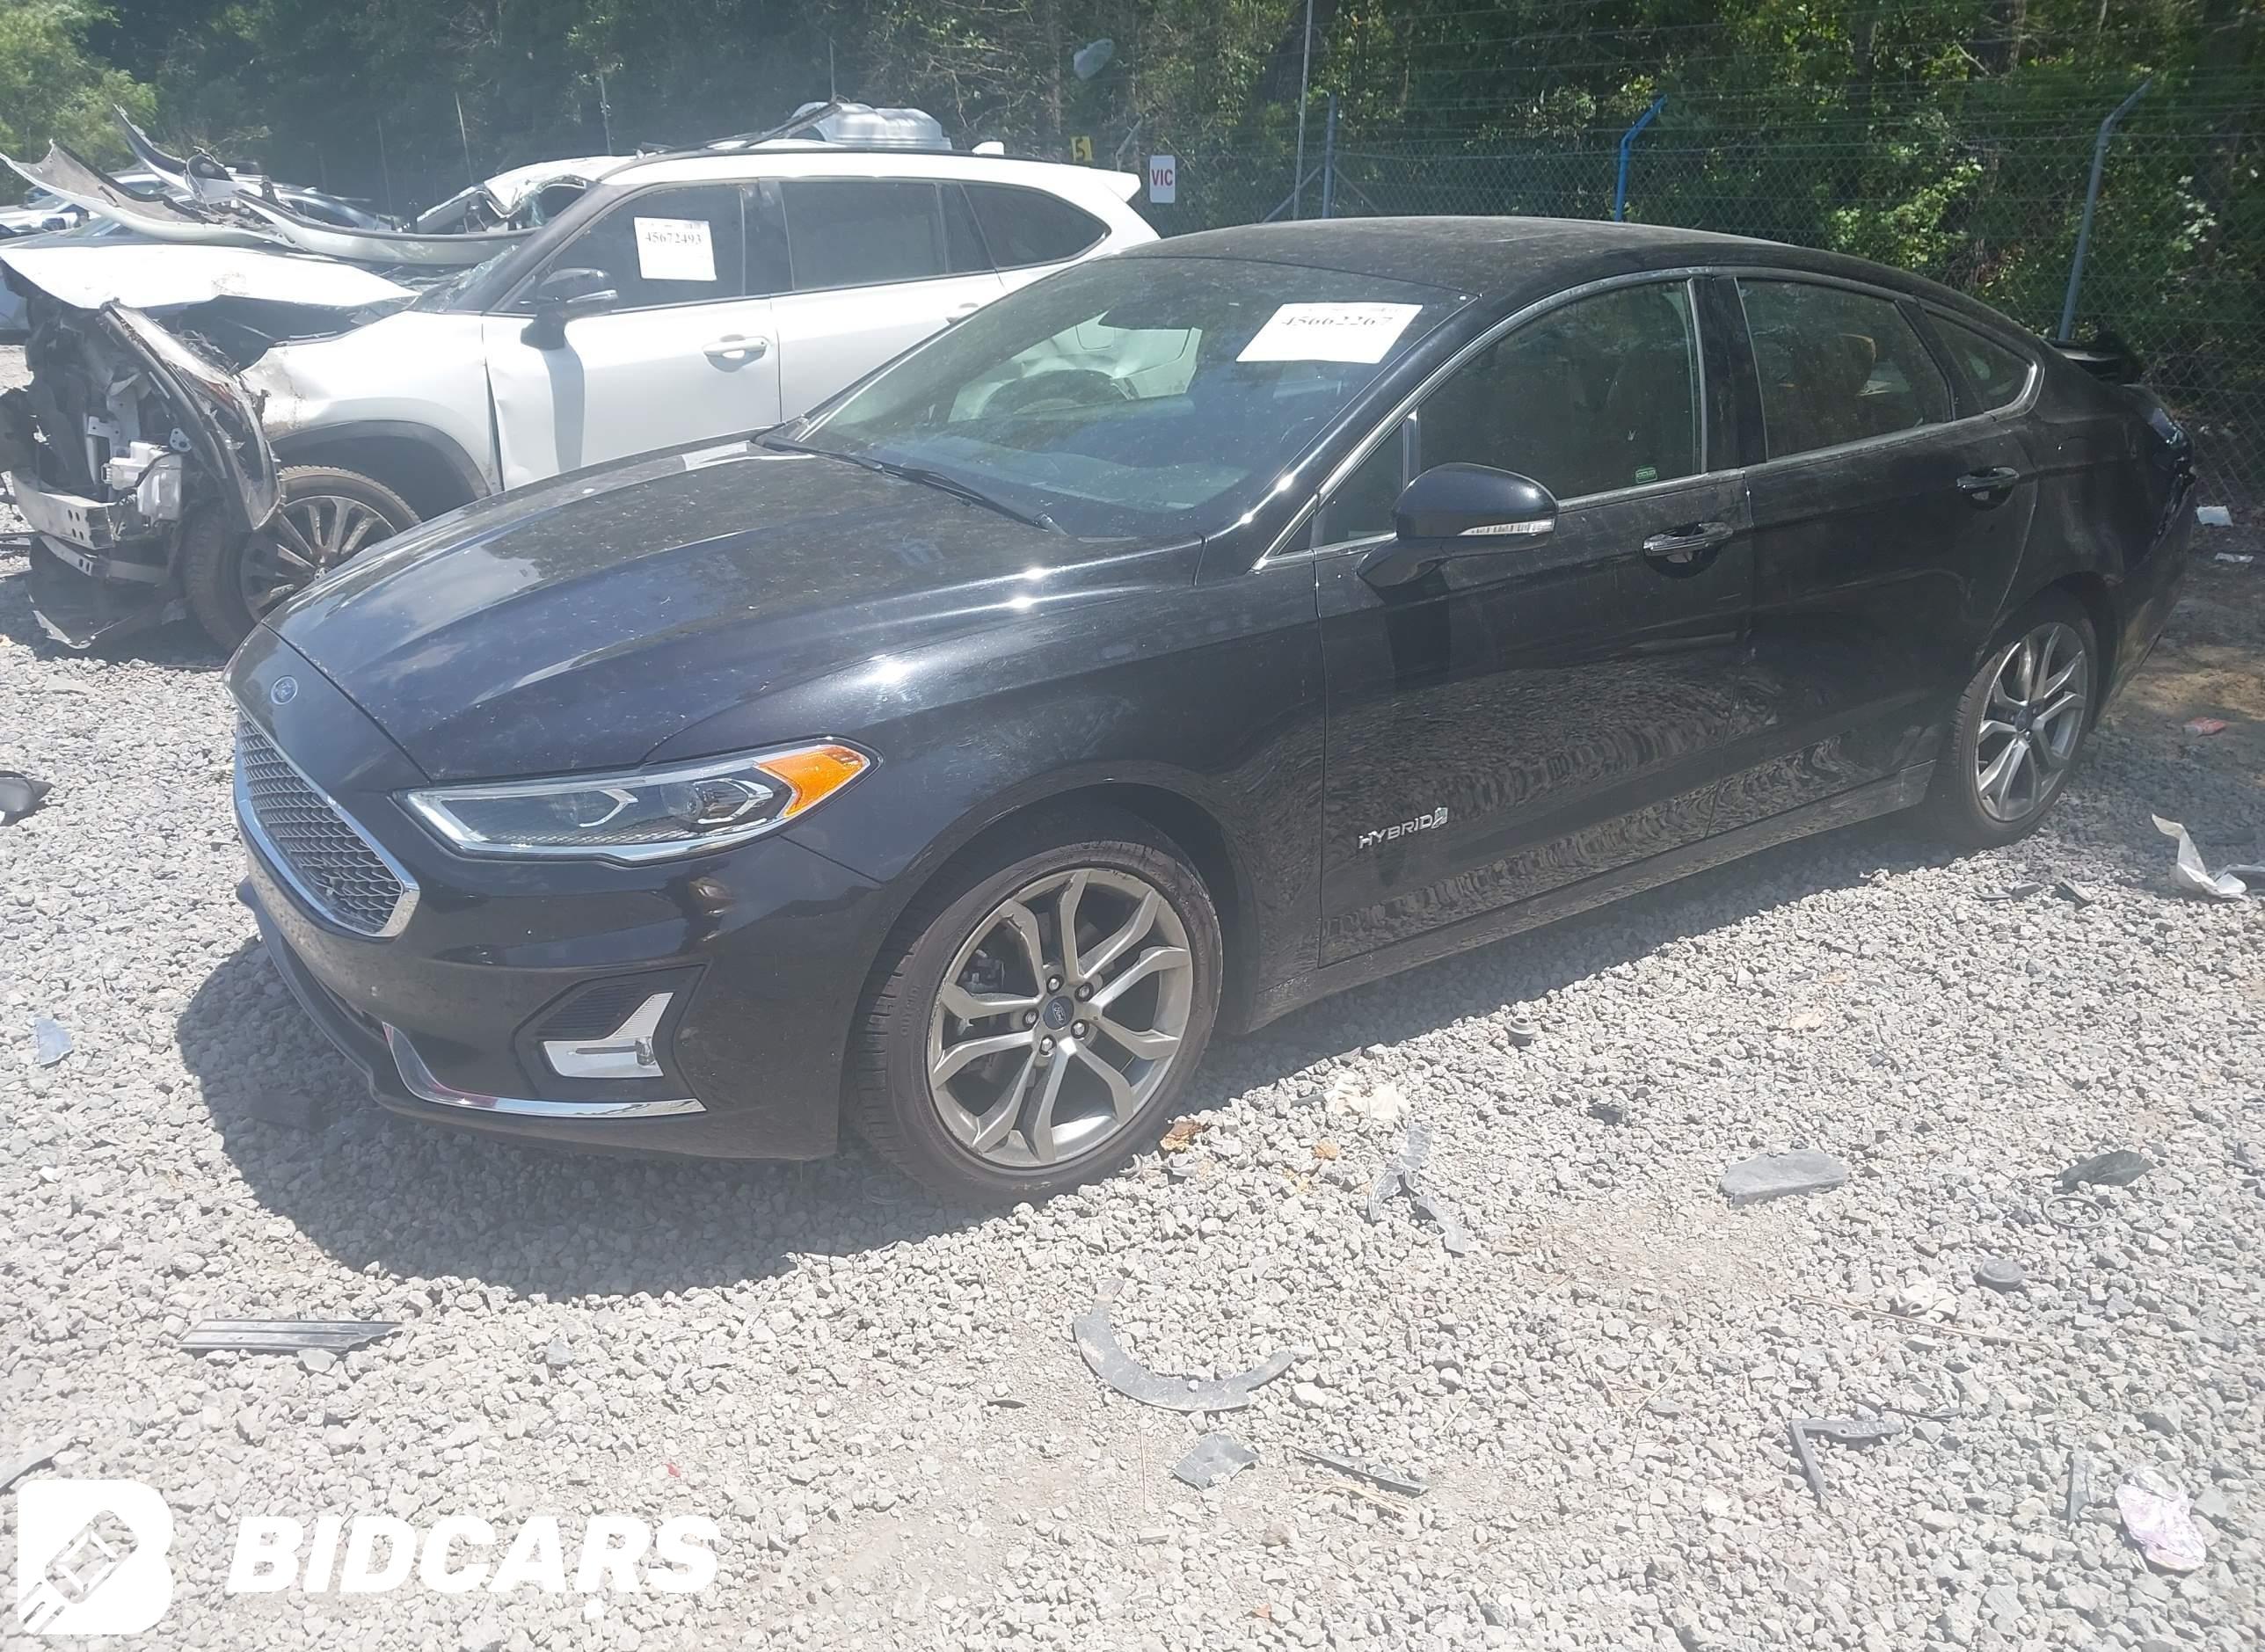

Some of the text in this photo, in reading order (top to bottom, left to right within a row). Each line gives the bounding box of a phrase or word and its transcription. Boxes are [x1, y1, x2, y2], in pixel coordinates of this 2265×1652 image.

[1152, 169, 1173, 186] VIC
[645, 231, 703, 245] 45672493
[1358, 814, 1433, 849] HYBRID
